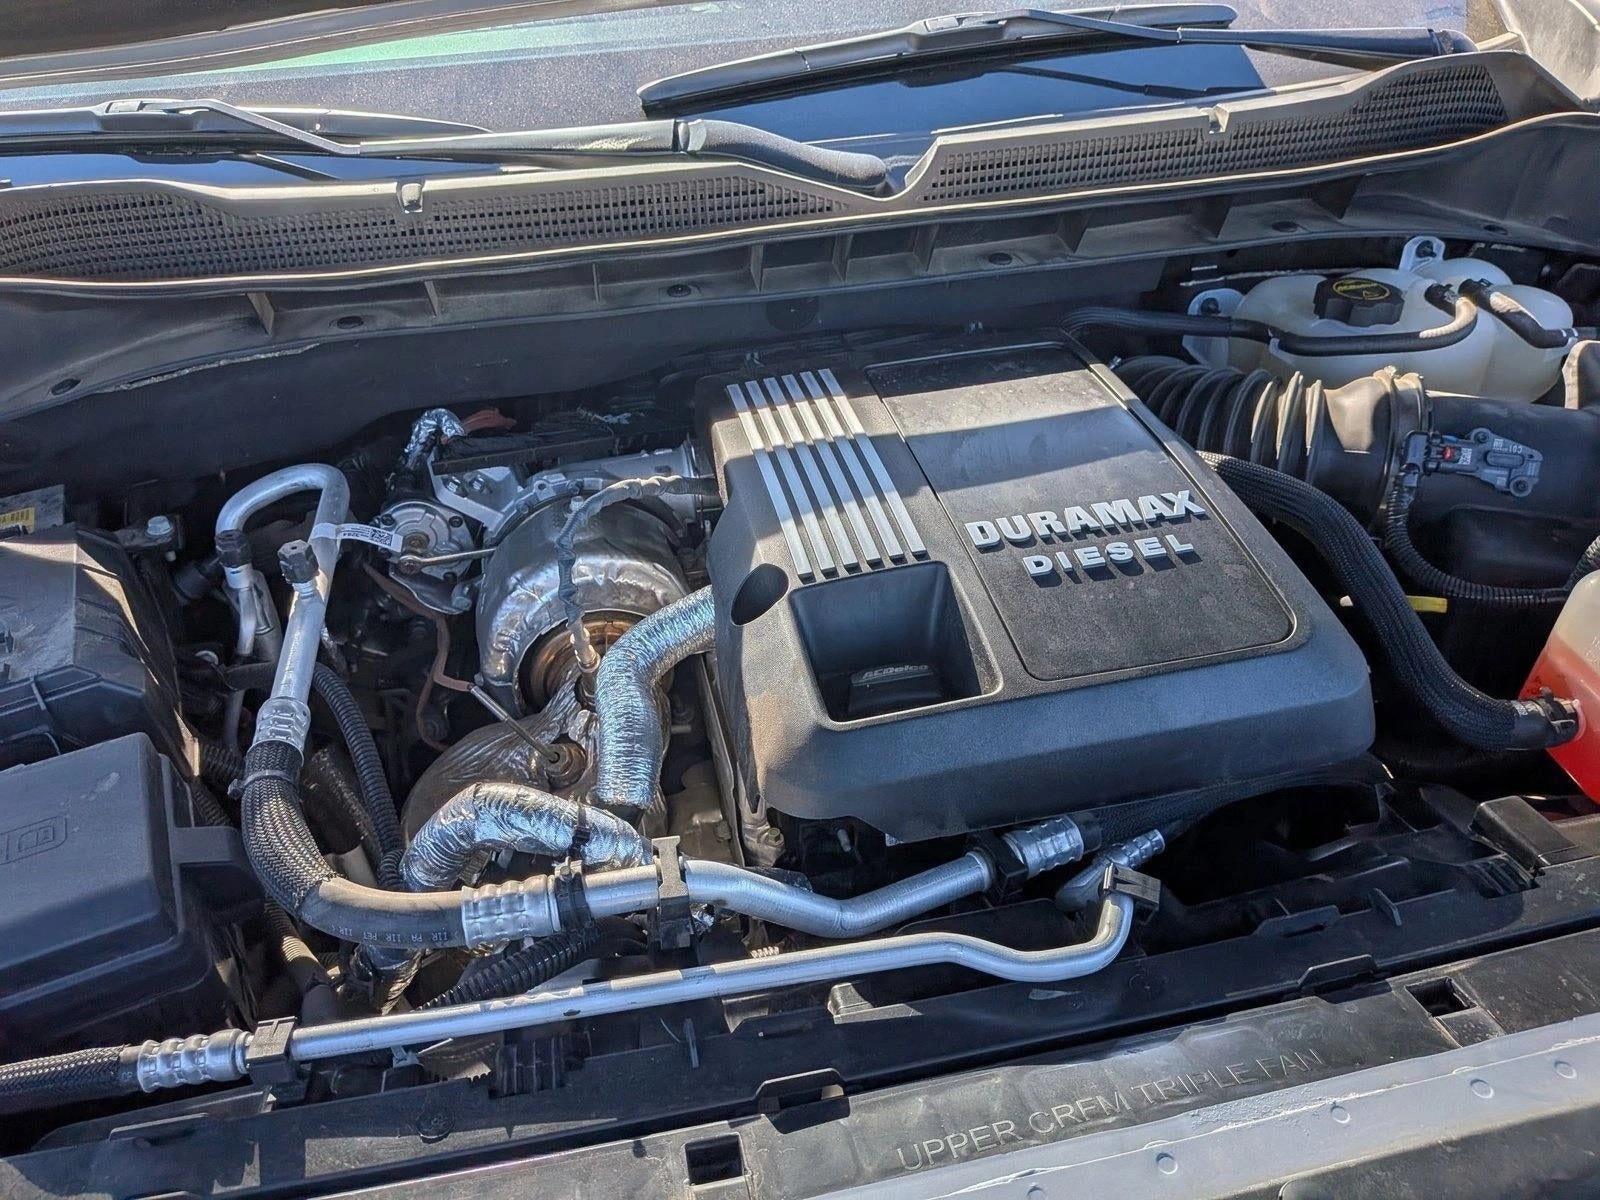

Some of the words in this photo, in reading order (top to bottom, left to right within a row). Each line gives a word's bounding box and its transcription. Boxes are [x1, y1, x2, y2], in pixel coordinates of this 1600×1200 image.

[964, 490, 1205, 549] DURAMAX
[1022, 534, 1194, 577] DIESEL
[898, 1119, 1024, 1171] UPPER
[1028, 1090, 1133, 1134] CRFM
[1130, 1062, 1258, 1105] TRIPLE
[1256, 1048, 1326, 1081] FAN
